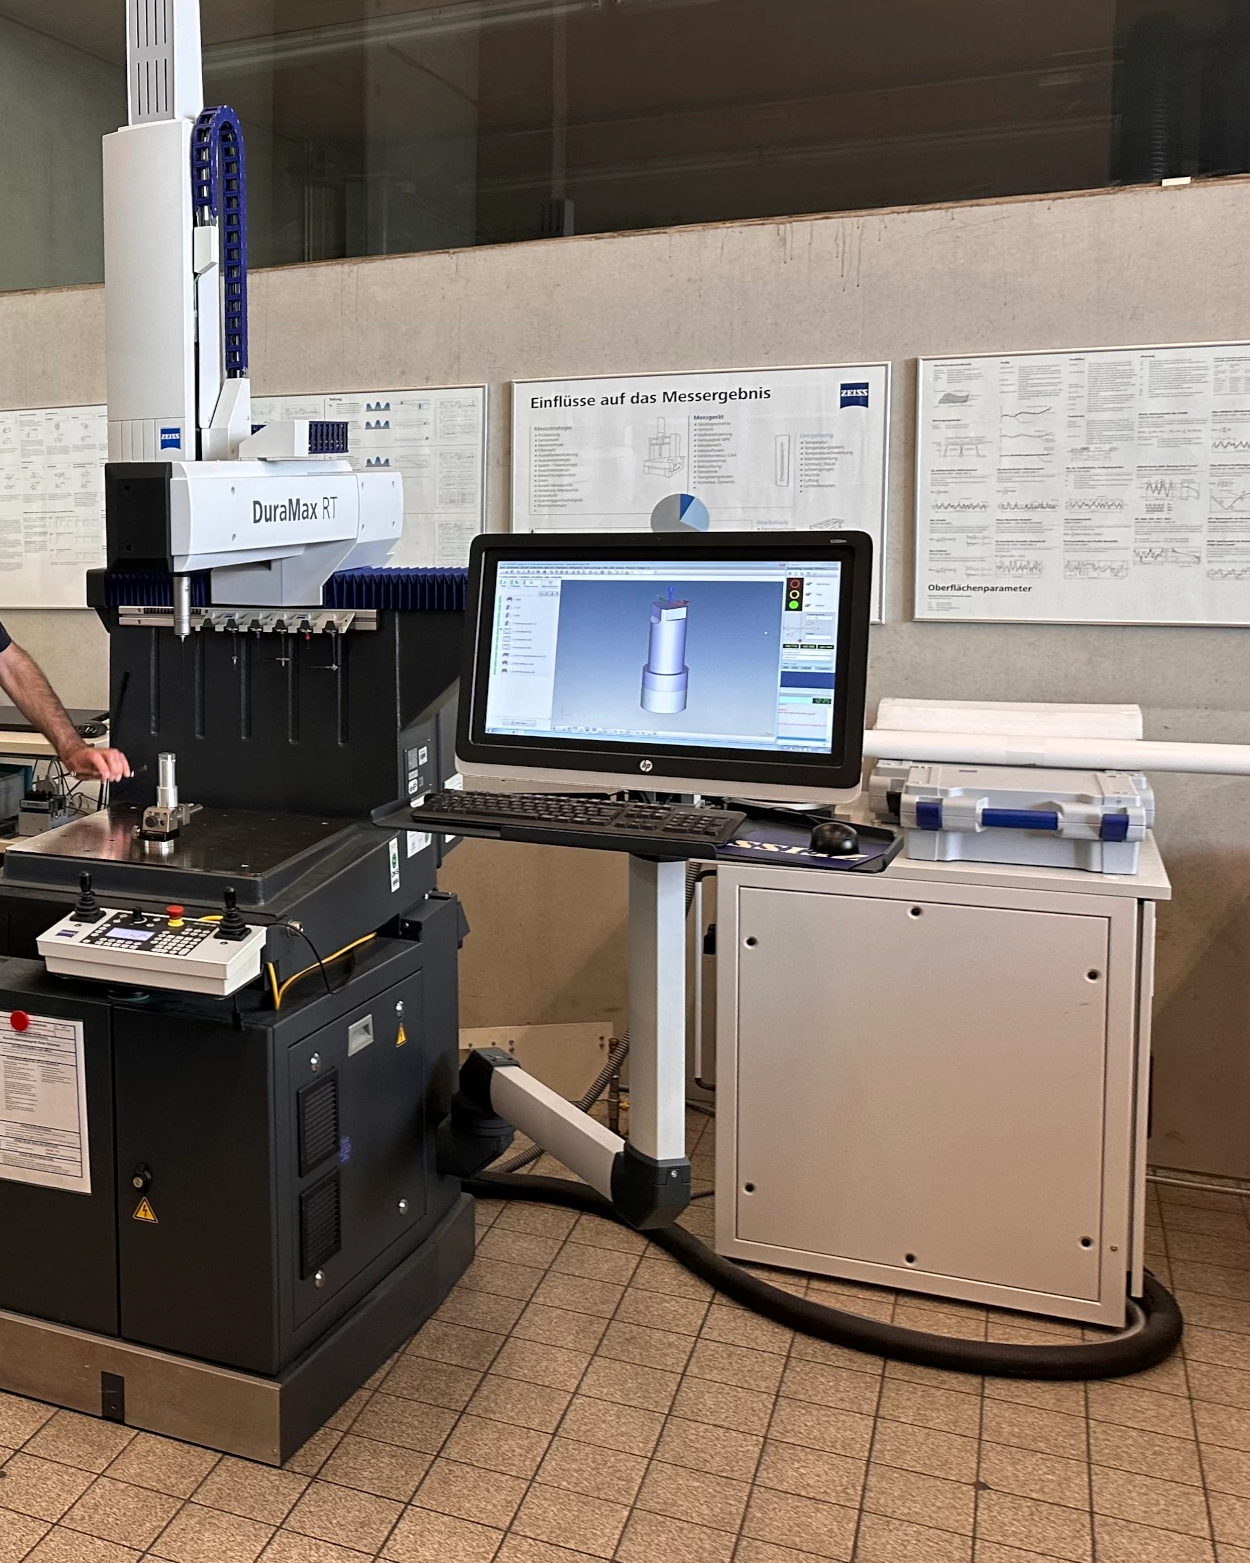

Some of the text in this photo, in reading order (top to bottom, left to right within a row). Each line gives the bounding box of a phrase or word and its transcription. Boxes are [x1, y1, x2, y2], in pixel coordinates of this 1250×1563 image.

[530, 386, 771, 409] Einflüsse auf das Messergebnis
[840, 389, 869, 397] ZEISS
[252, 496, 338, 524] DuraMax RT
[927, 584, 1033, 593] Oberflächenparameter
